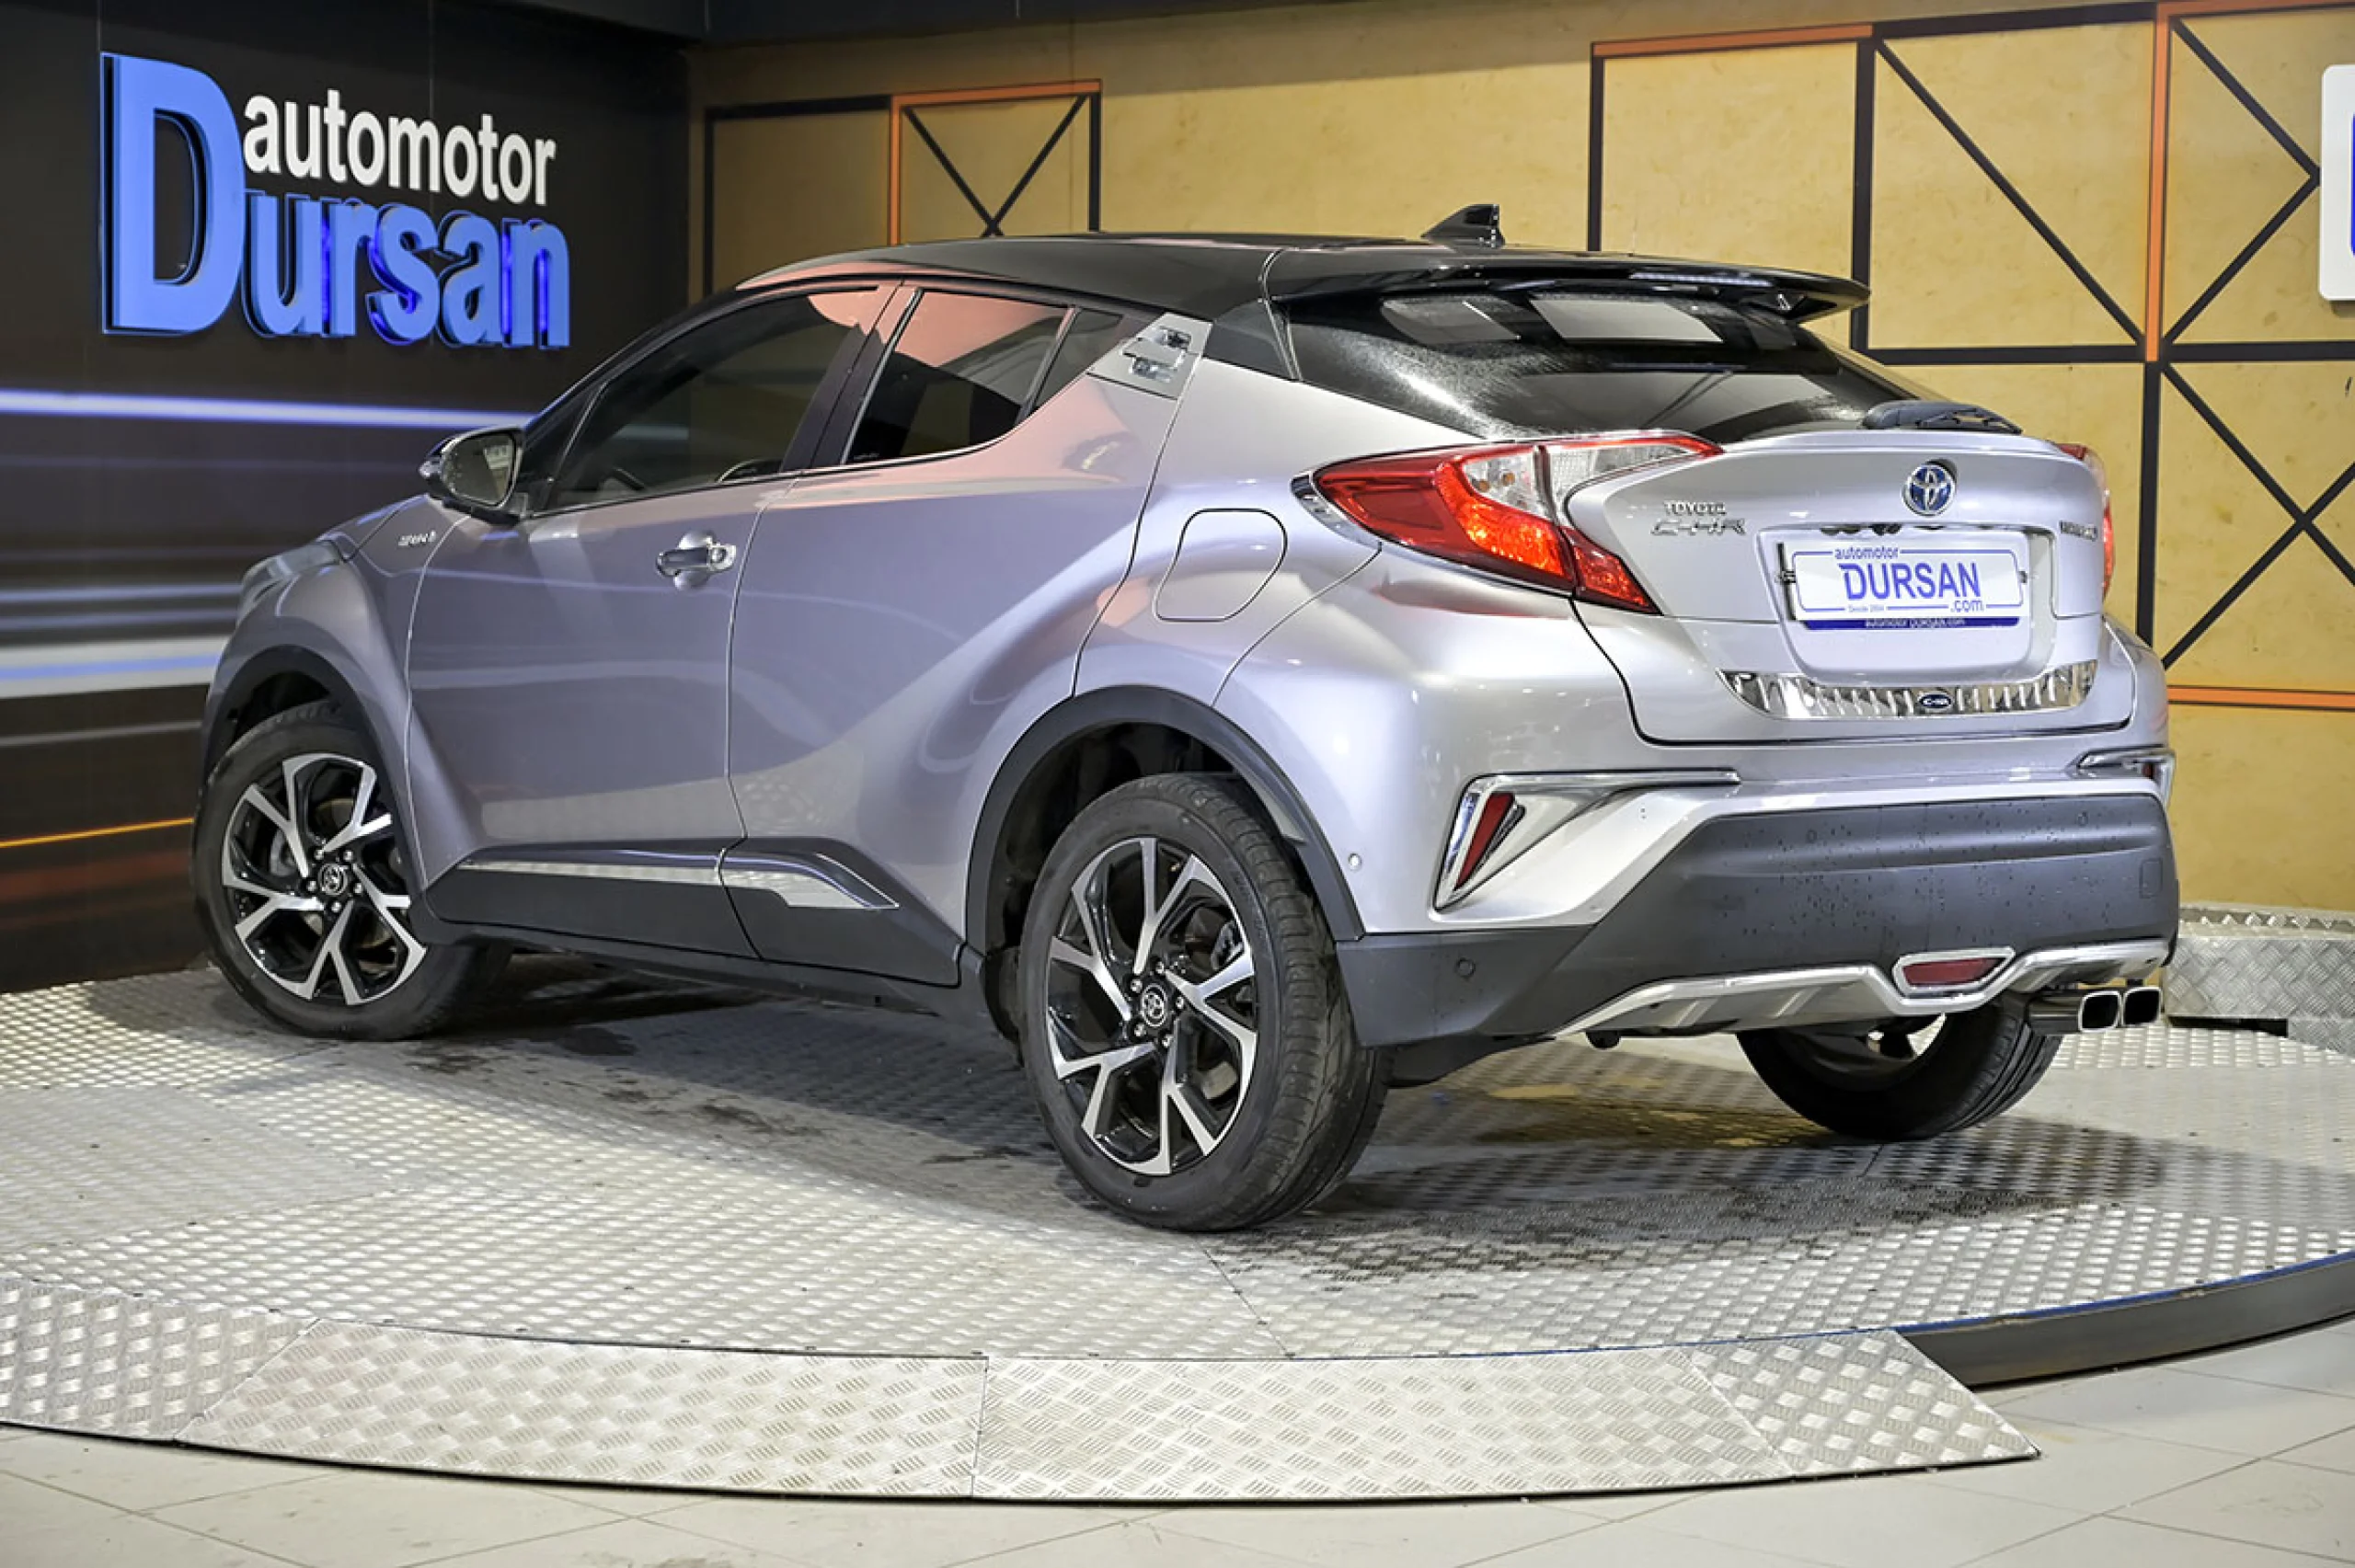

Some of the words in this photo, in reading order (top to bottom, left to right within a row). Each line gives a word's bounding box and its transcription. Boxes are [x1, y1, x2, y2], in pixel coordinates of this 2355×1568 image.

[243, 89, 557, 205] automotor
[100, 52, 569, 349] Dursan
[1834, 545, 1899, 559] automotor
[1838, 562, 1982, 601] DURSAN
[1950, 599, 1984, 613] .com
